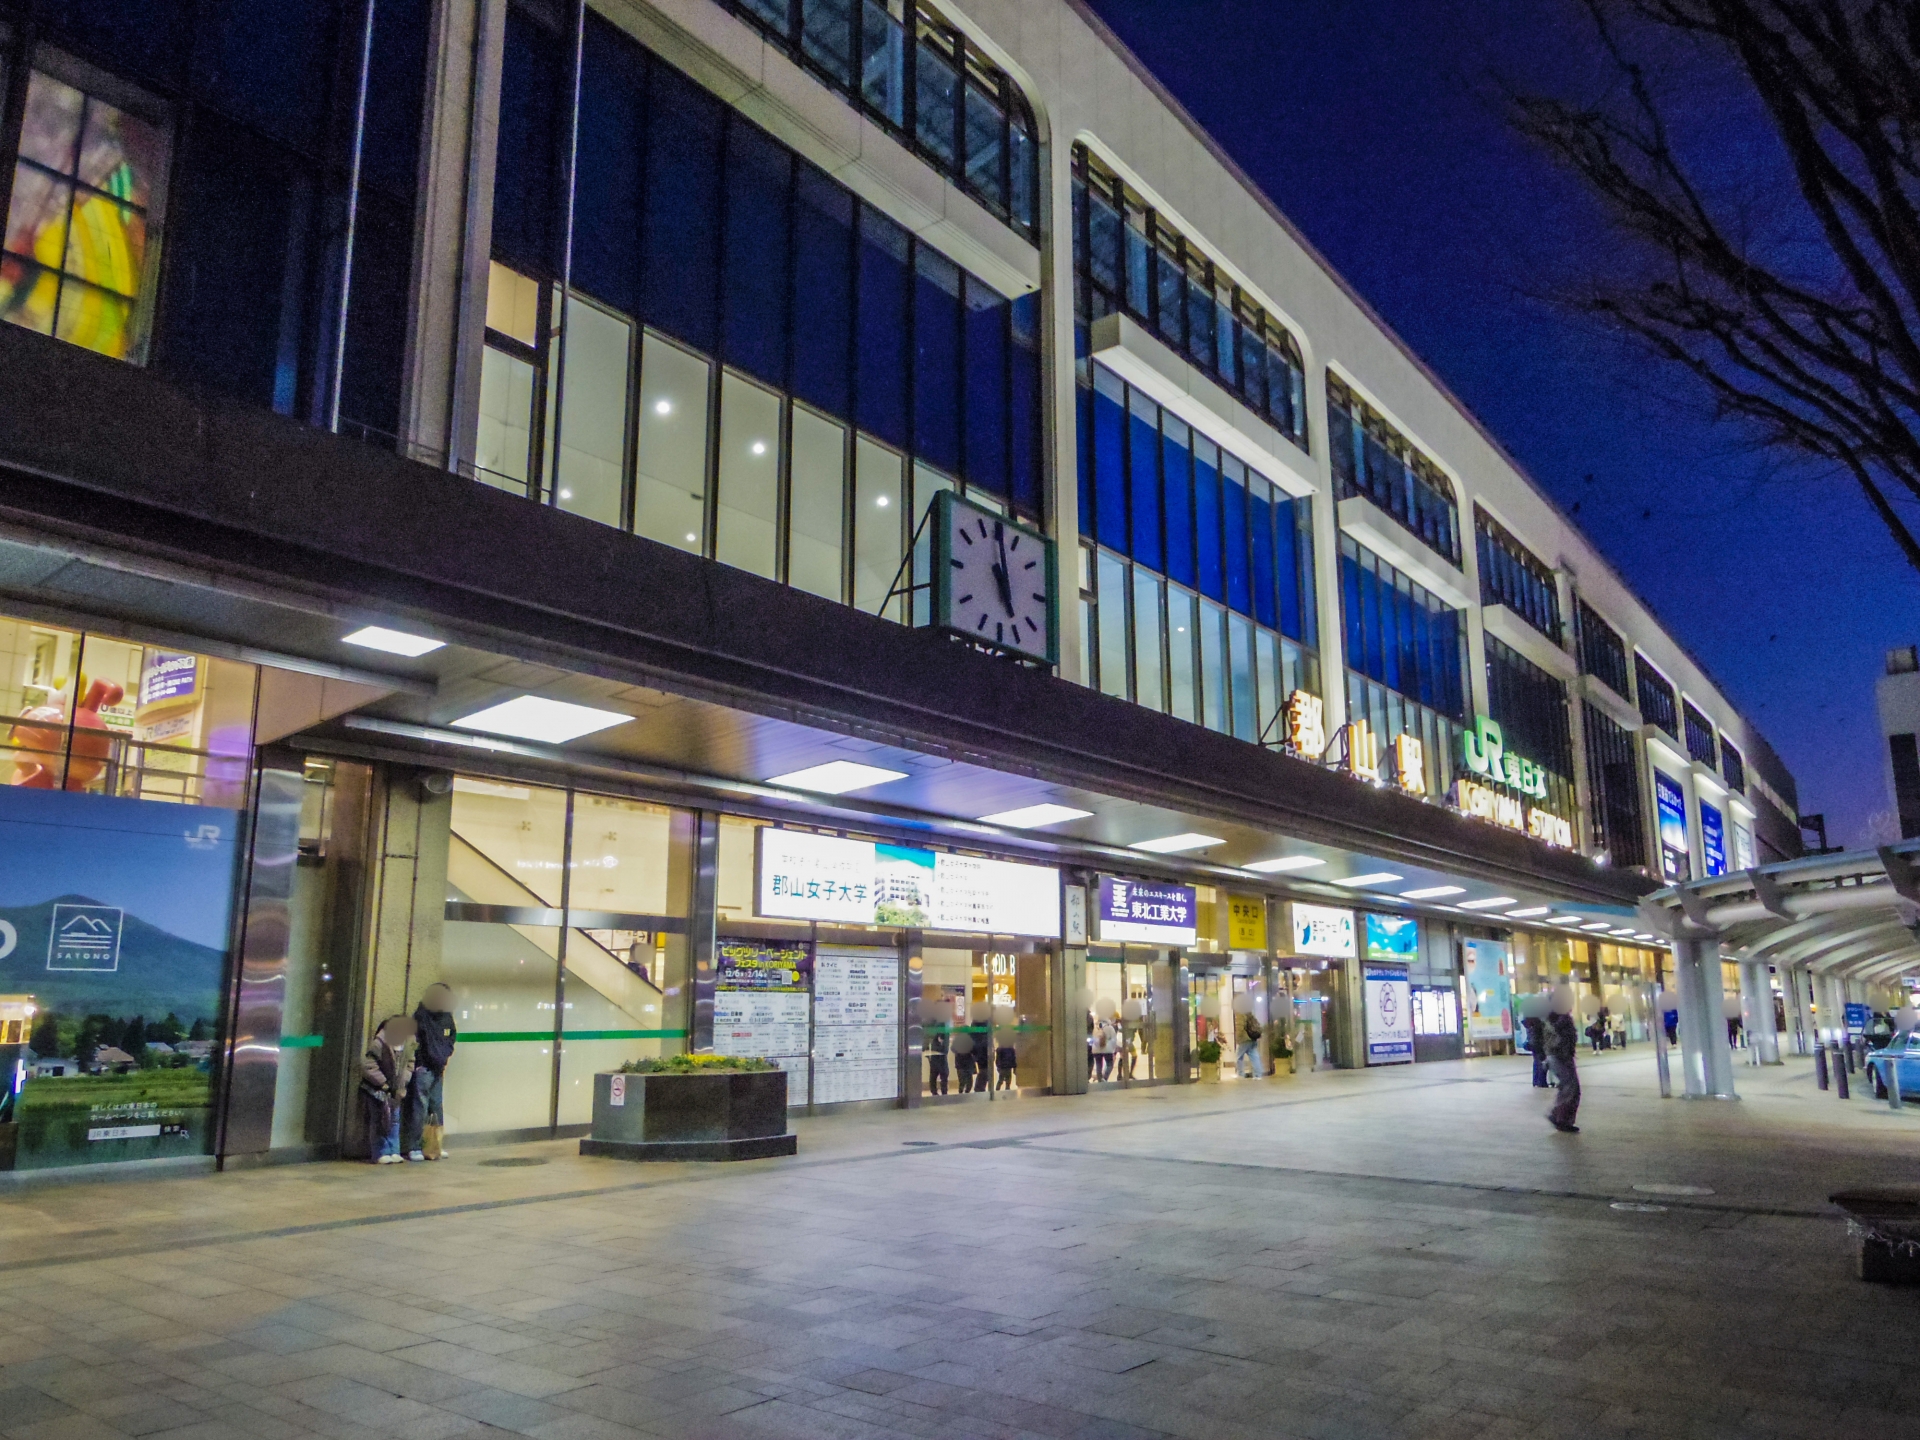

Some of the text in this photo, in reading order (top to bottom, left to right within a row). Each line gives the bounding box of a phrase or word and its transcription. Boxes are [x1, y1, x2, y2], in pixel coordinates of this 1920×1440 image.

[1290, 689, 1425, 793] 郡山駅
[1464, 715, 1547, 798] JR東日本
[1458, 779, 1572, 847] KORIYAMA STATION
[184, 825, 220, 845] JR
[772, 874, 867, 904] 郡山女子大学
[1131, 901, 1187, 922] 東北工業大学
[1233, 904, 1259, 918] 中央口
[57, 952, 111, 960] SATONO
[92, 1129, 128, 1138] JR東日本
